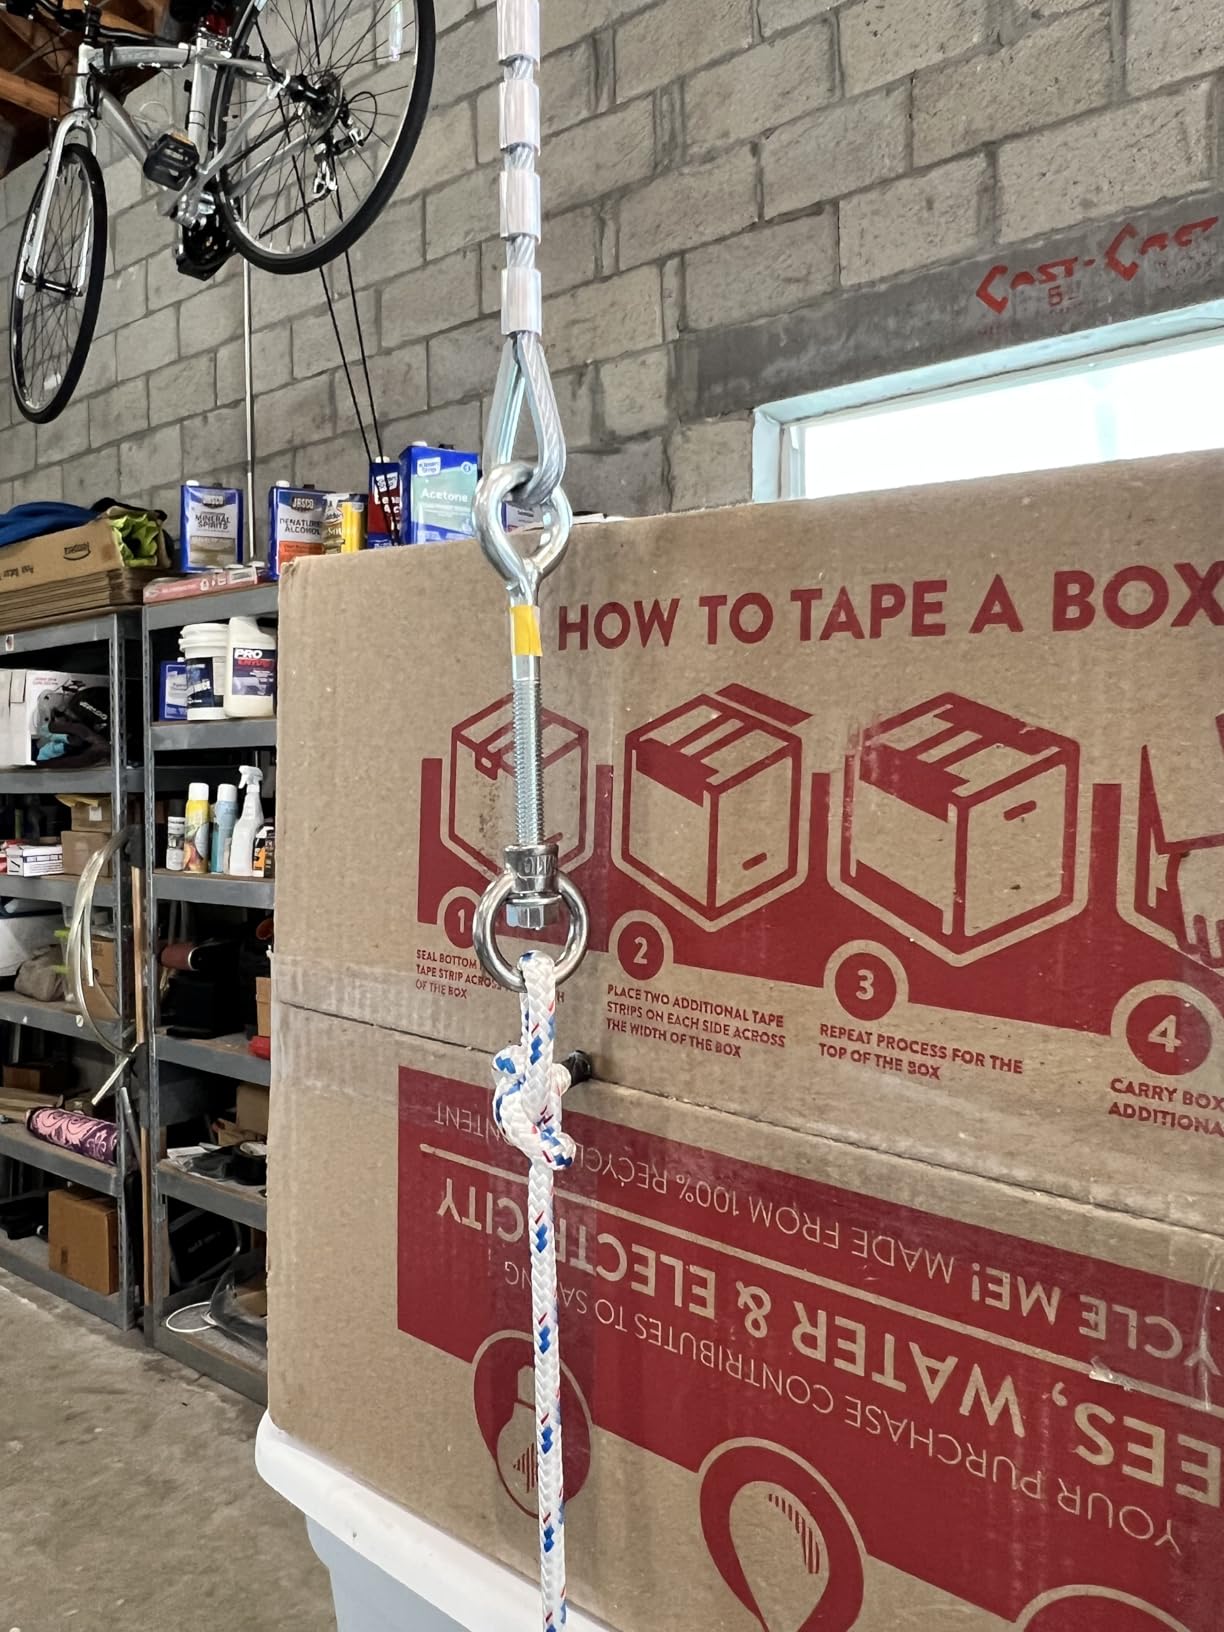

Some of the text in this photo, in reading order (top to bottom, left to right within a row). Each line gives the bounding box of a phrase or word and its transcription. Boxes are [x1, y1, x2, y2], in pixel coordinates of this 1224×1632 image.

[421, 488, 468, 503] Acetone
[558, 560, 1224, 652] HOW TO TAPE A BOX
[234, 649, 262, 659] PRO
[457, 909, 465, 934] 1
[416, 949, 438, 963] SEAL
[439, 953, 477, 969] BOTTOM
[633, 936, 648, 965] 2
[415, 980, 467, 999] OF THE BOX
[416, 964, 437, 978] TAPE
[438, 968, 463, 982] STRIP
[855, 969, 875, 1000] 3
[607, 984, 784, 1028] PLACE TWO ADDITIONAL TAPE
[607, 1001, 786, 1048] STRIPS ON EACH SIDE ACROSS
[606, 1017, 742, 1058] THE WIDTH OF THE BOX
[820, 1024, 1024, 1075] REPEAT PROCESS FOR THE
[1148, 1014, 1183, 1053] 4
[818, 1043, 941, 1081] TOP OF THE BOX
[1110, 1078, 1224, 1113] CARRY BOX
[576, 1143, 668, 1195] RECYCL
[675, 1173, 738, 1217] 100%
[749, 1194, 840, 1250] FROM
[851, 1226, 955, 1284] MADE
[594, 1298, 628, 1334] TO
[736, 1280, 772, 1339] &
[971, 1262, 1061, 1326] ME!
[635, 1312, 834, 1415] CONTRIBUTES
[791, 1300, 1026, 1439] WATER
[845, 1395, 1044, 1501] PURCHASE
[1057, 1478, 1183, 1556] YOUR
